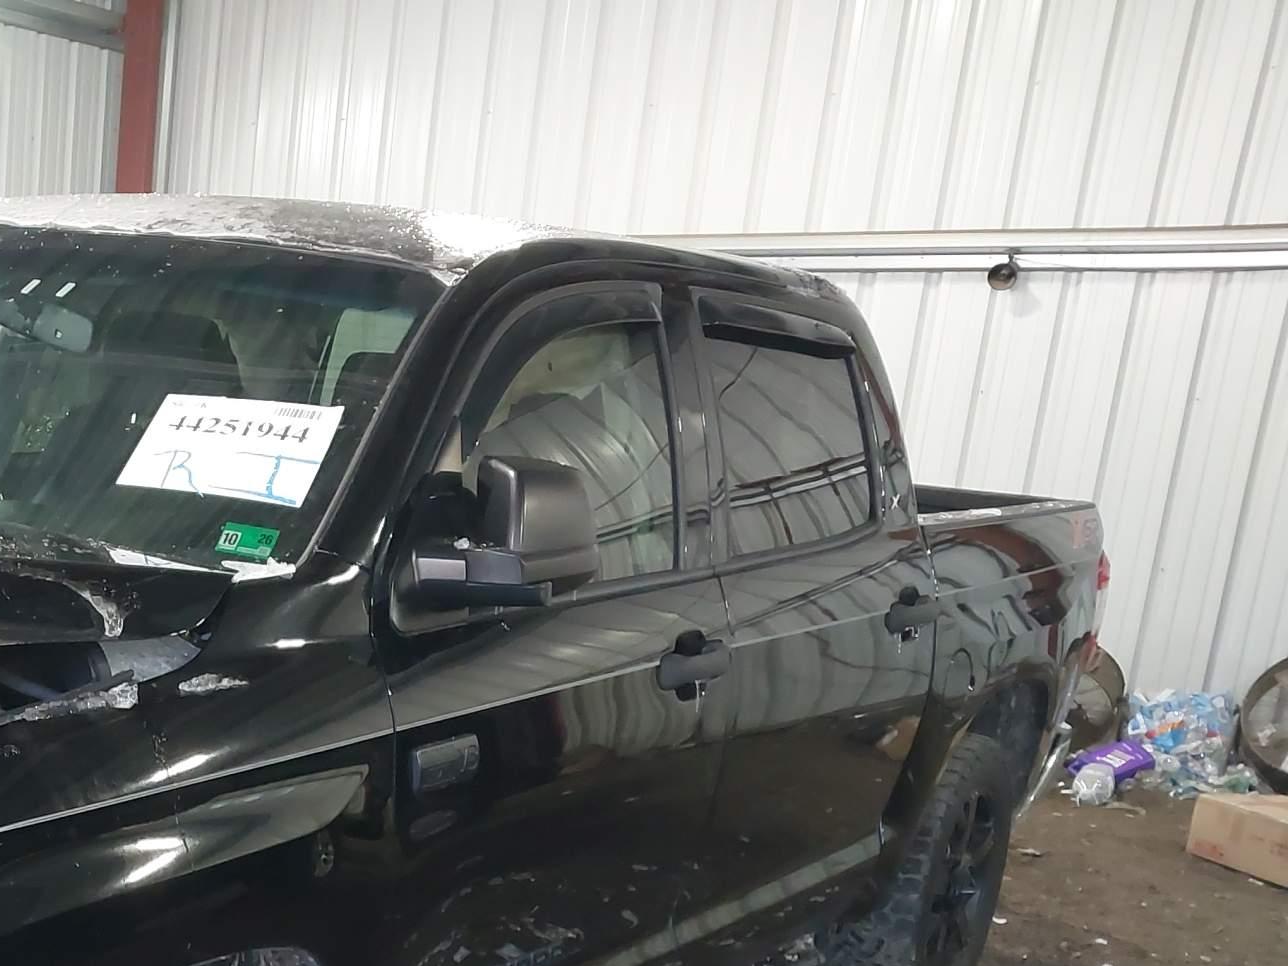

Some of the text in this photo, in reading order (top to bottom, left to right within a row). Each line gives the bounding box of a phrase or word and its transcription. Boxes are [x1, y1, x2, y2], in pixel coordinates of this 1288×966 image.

[168, 415, 310, 443] 44251944
[222, 532, 274, 546] 10 26
